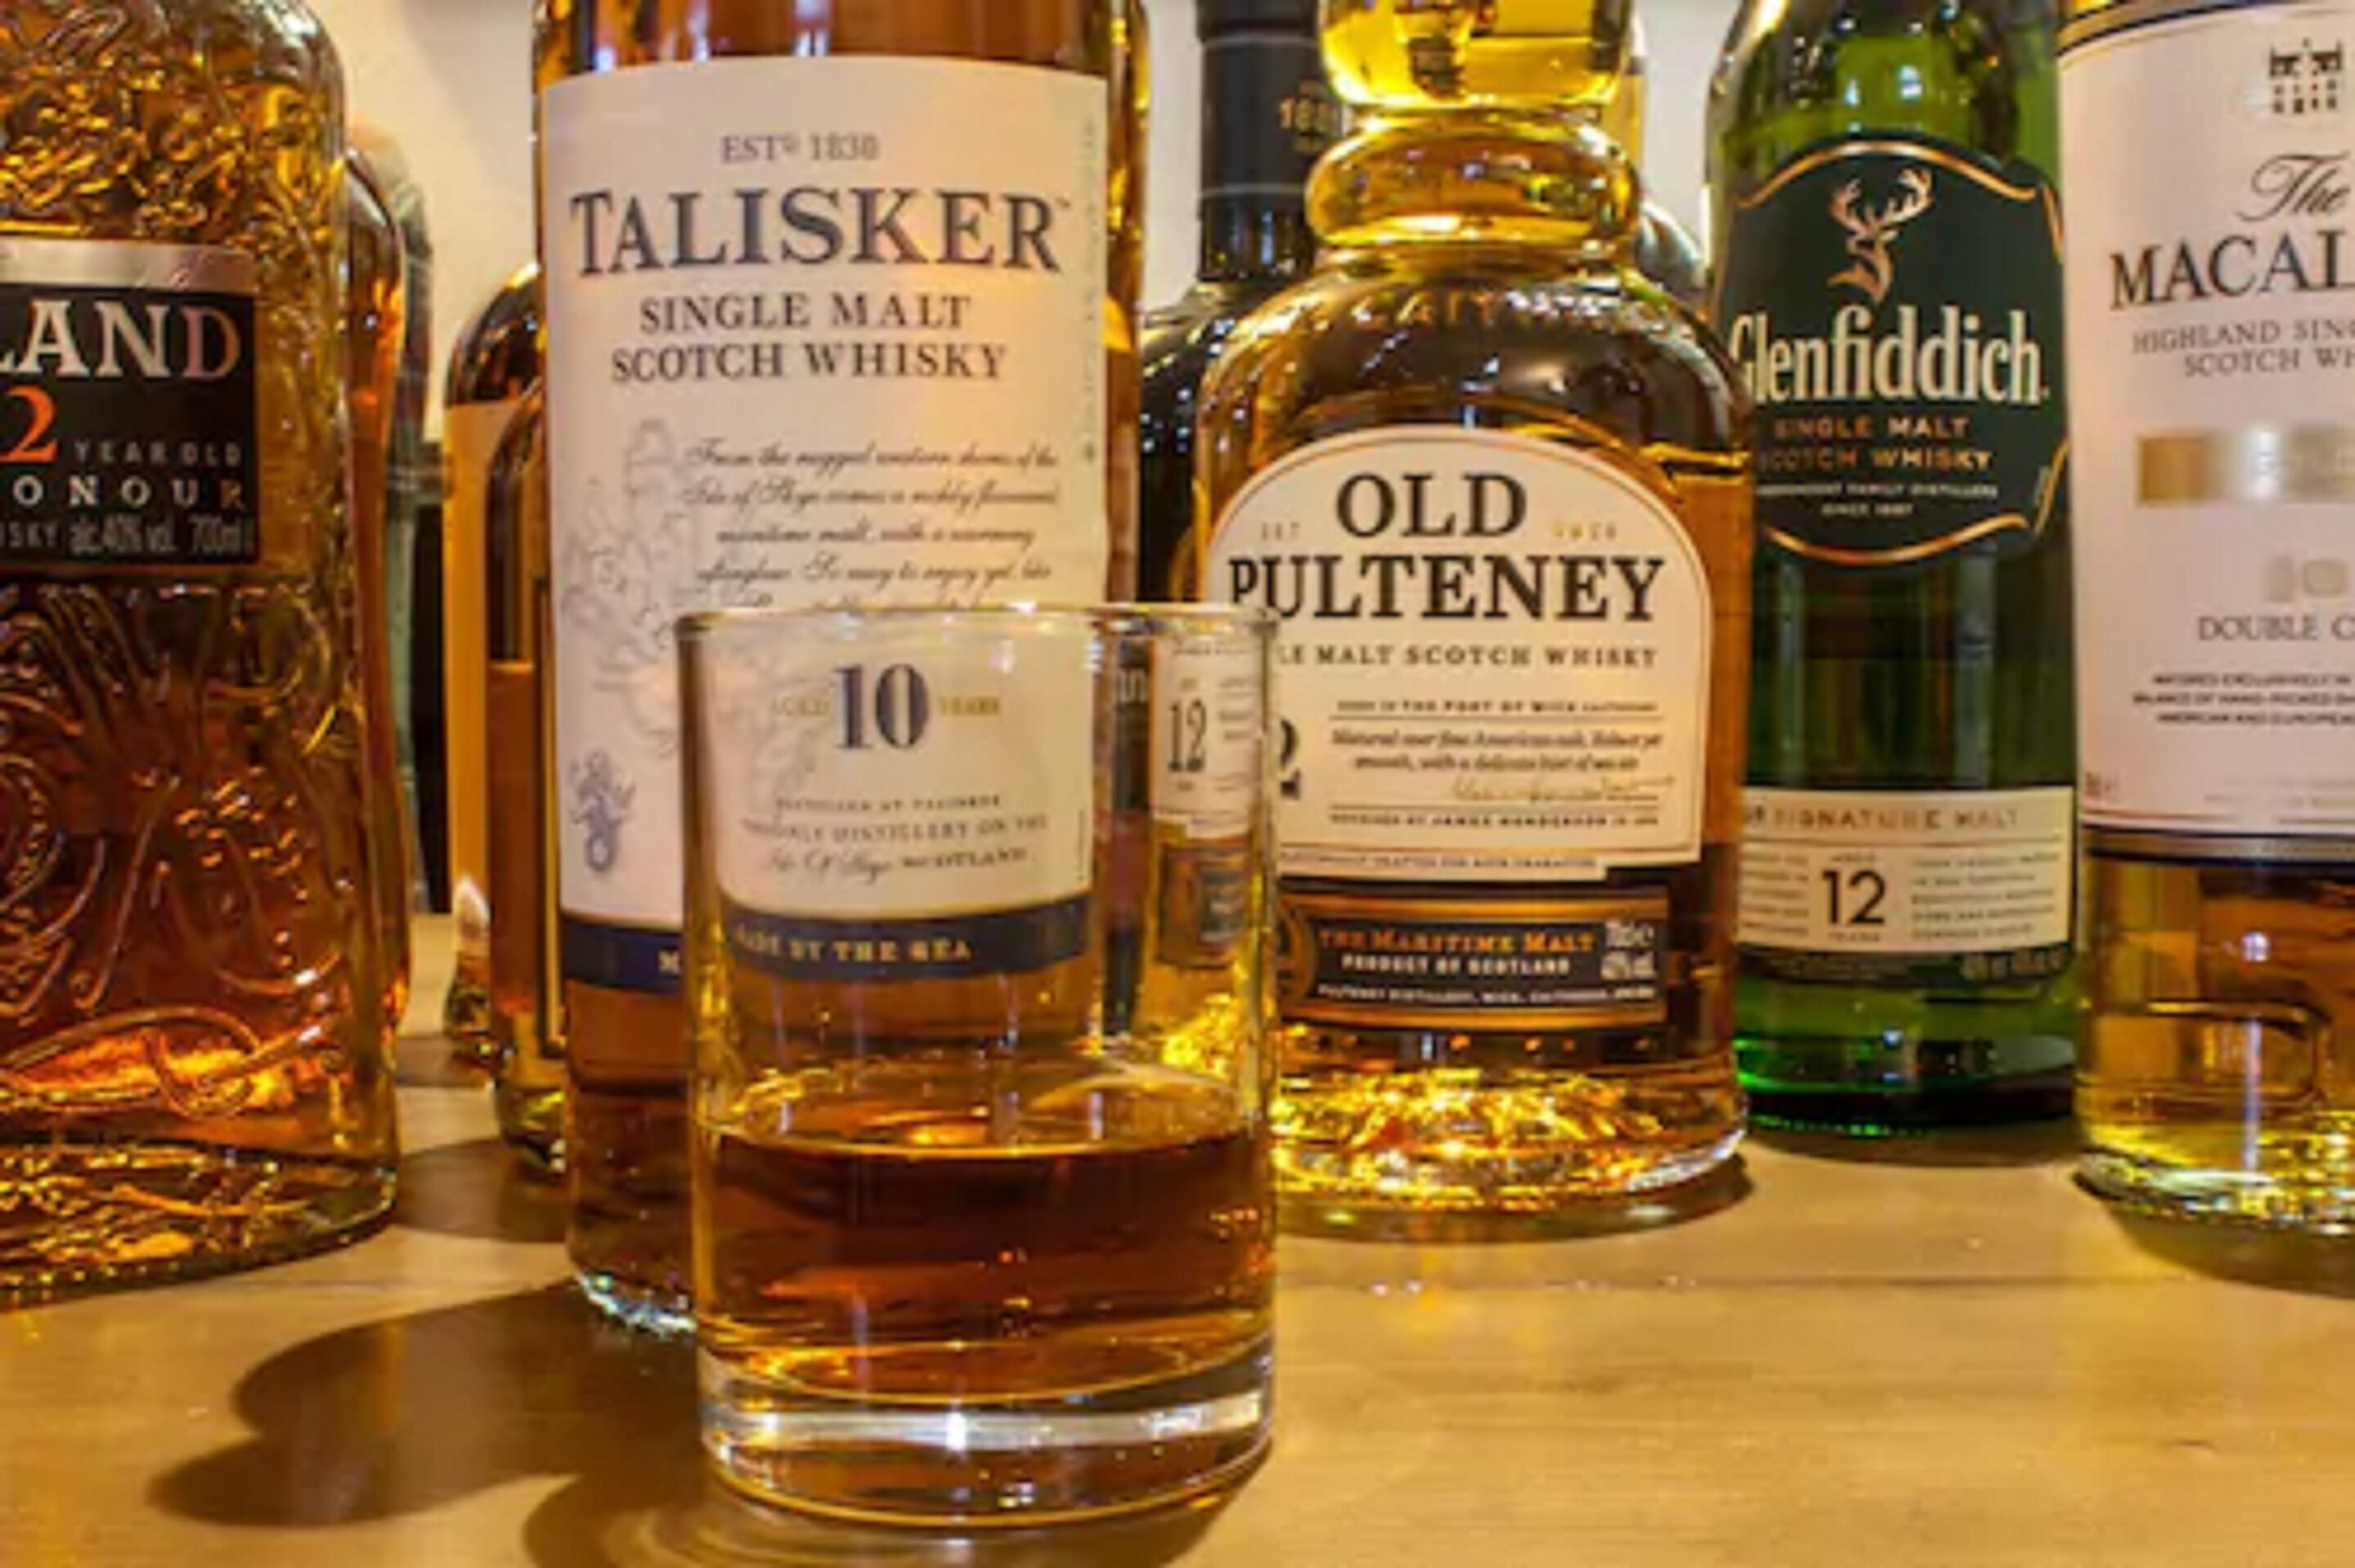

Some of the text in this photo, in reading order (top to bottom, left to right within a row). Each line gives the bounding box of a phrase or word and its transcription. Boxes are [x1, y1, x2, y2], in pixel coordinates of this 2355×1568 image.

[810, 133, 880, 161] 1830
[2235, 150, 2352, 222] The
[572, 186, 1062, 278] TALISKER
[639, 293, 971, 335] SINGLE MALT
[1729, 304, 2042, 404] Glenfiddich
[2133, 320, 2281, 354] HIGHLAND
[611, 343, 1007, 383] SCOTCH WHISKY
[2184, 347, 2299, 377] SCOTCH
[0, 385, 241, 467] 2 YEAR OLD
[1774, 417, 1969, 439] SINGLE MALT
[1873, 448, 1994, 470] WHISKY
[1336, 472, 1527, 538] OLD
[1228, 555, 1663, 621] PULTENEY
[2198, 616, 2318, 641] DOUBLE
[1317, 647, 1391, 665] MALT
[1406, 647, 1531, 666] SCOTCH
[1545, 648, 1658, 667] WHISKY
[832, 663, 931, 750] 10
[1167, 697, 1206, 773] 12
[1774, 808, 1942, 831] SIGNATURE
[1958, 809, 2018, 831] MALT
[1822, 868, 1886, 925] 12
[832, 940, 899, 961] THE
[908, 938, 972, 961] SEA
[1524, 930, 1594, 952] MALT
